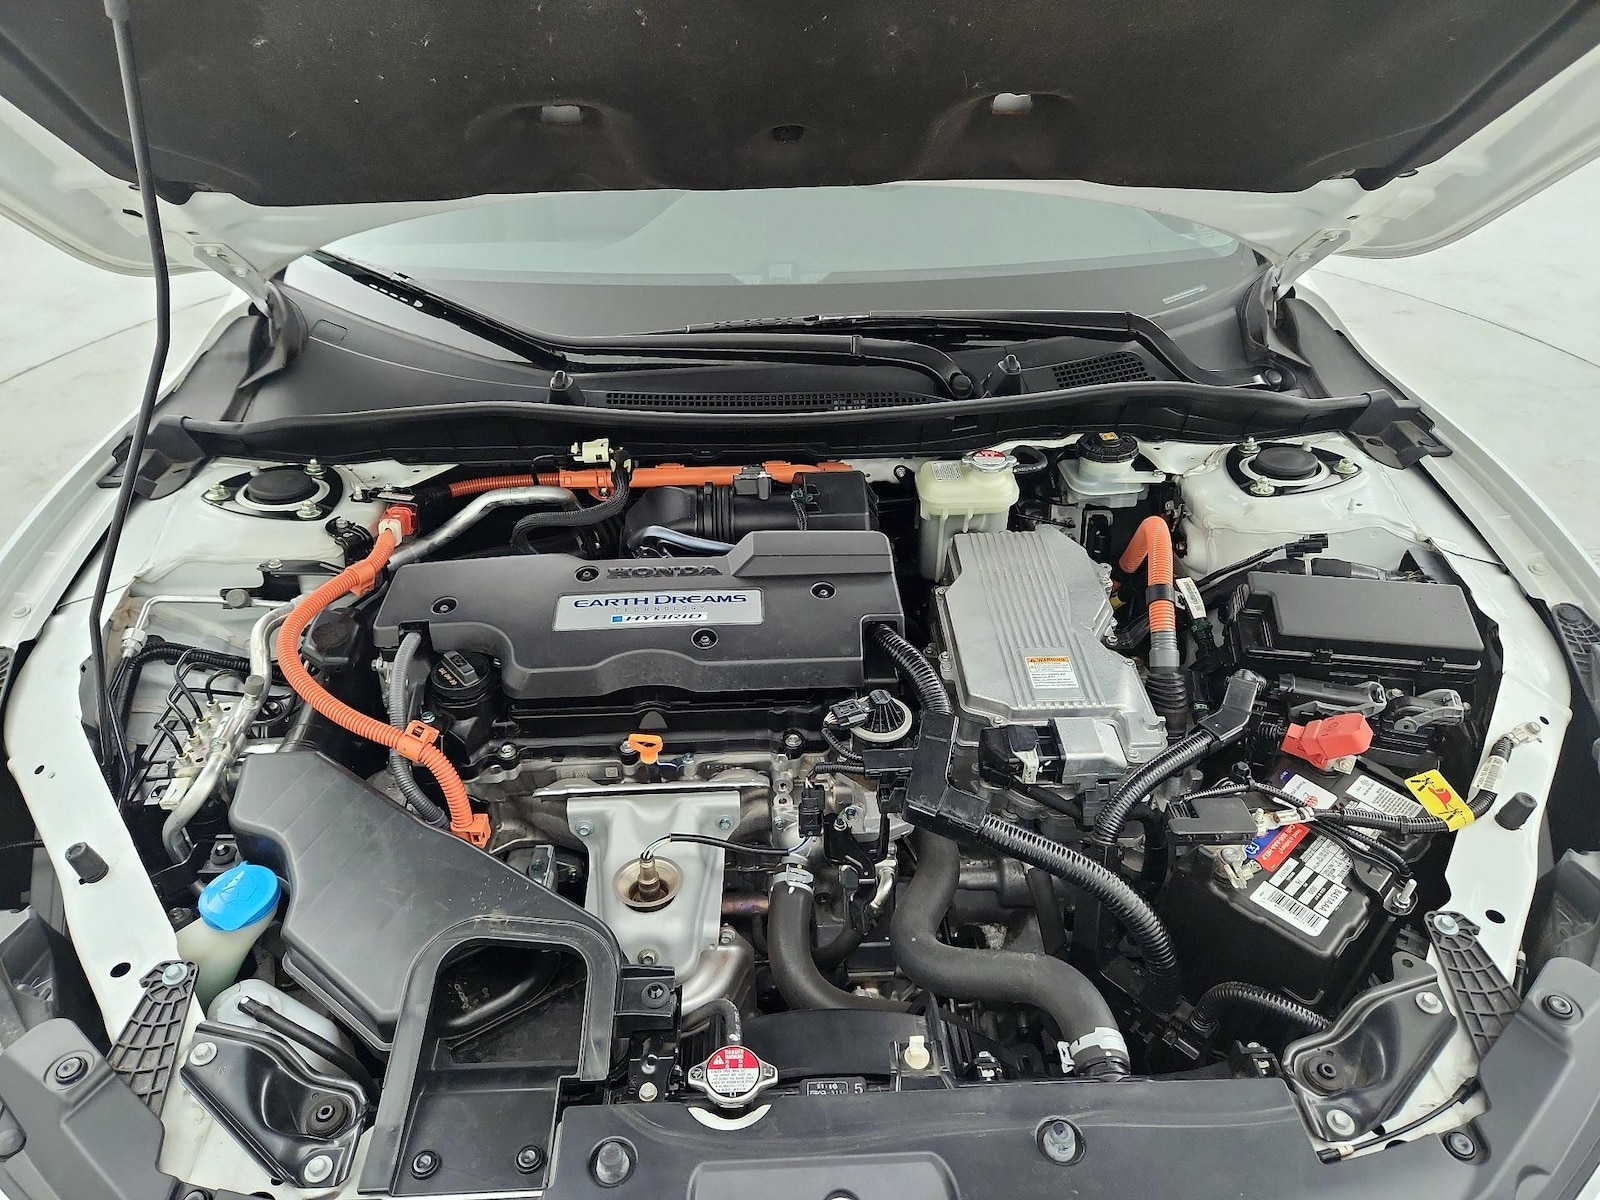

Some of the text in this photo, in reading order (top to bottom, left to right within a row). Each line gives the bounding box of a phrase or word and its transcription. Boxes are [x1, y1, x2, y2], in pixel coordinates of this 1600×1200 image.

[607, 566, 723, 580] HONDA
[574, 594, 747, 607] EARTH DREAMS
[625, 613, 702, 621] HYBRID
